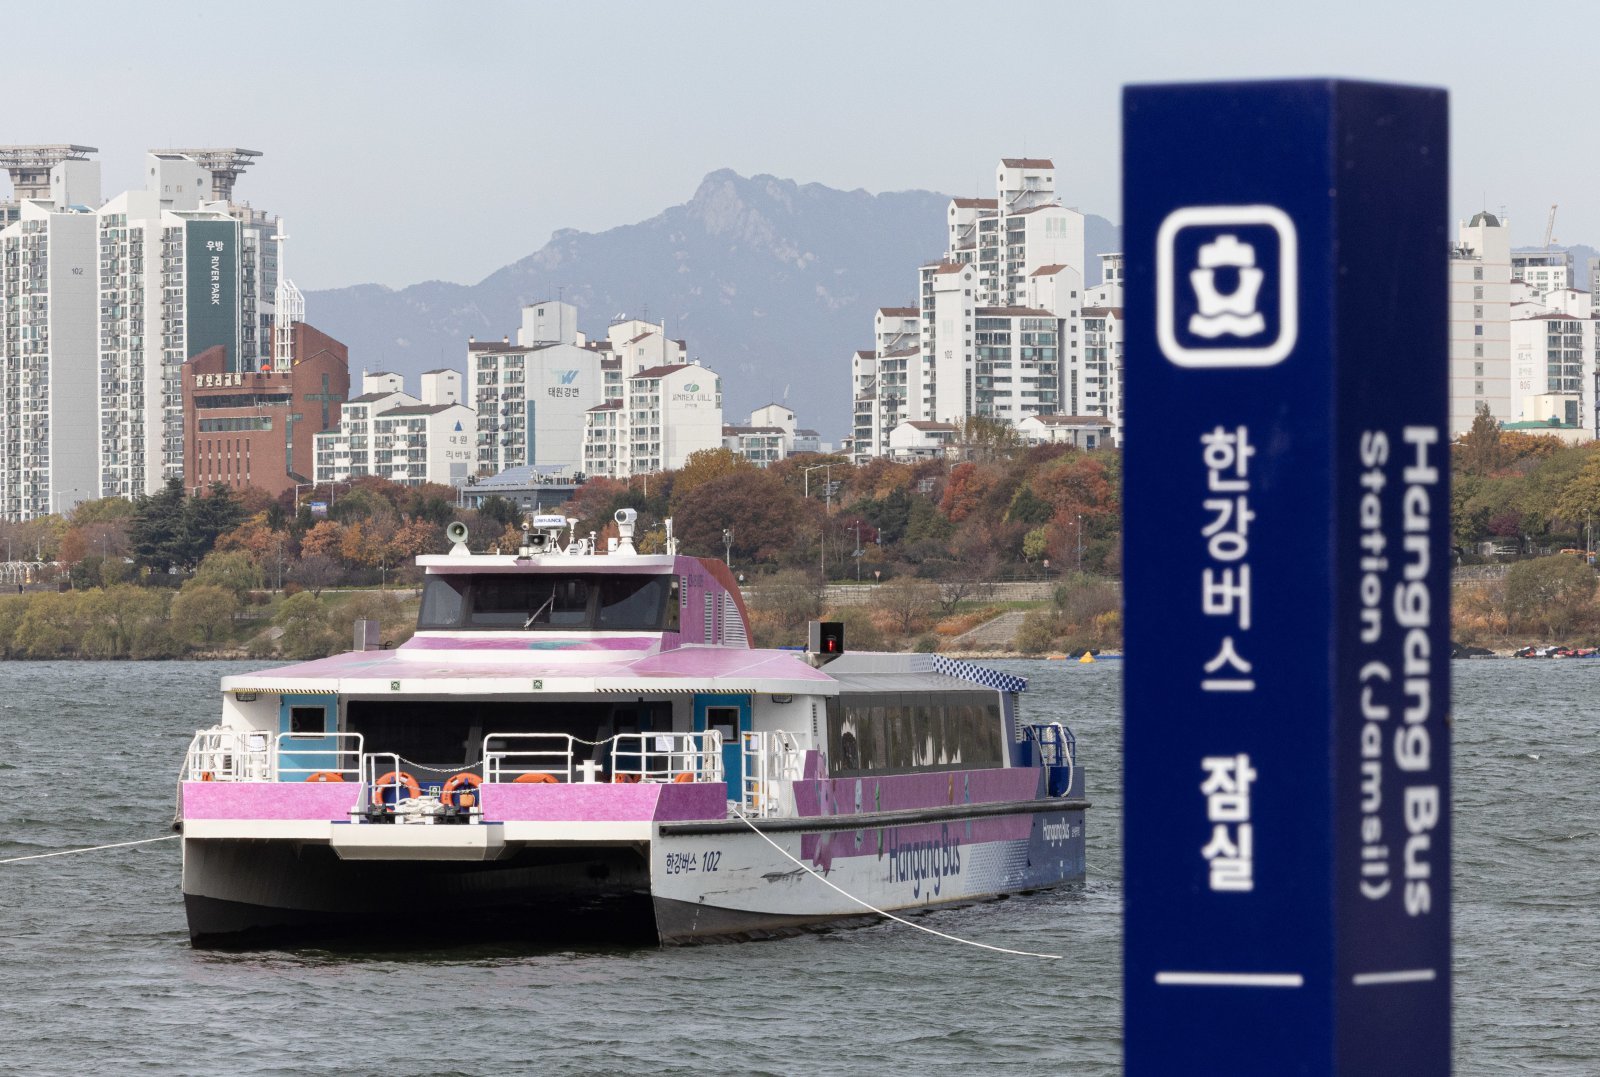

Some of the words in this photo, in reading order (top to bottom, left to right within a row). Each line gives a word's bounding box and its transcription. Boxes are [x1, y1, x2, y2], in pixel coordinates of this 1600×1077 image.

[71, 267, 83, 275] 102
[206, 241, 224, 251] 우방
[211, 256, 220, 282] RIVER
[211, 283, 220, 305] PARK
[1199, 425, 1257, 692] 한강버스
[1359, 431, 1390, 644] Station
[1394, 425, 1439, 771] Hangang
[1200, 753, 1257, 891] 잠실
[1359, 660, 1391, 901] (Jamsil)
[666, 852, 697, 875] 한강버스
[702, 850, 722, 873] 102
[889, 827, 941, 899] Hangang
[942, 823, 961, 876] Bus
[1403, 786, 1439, 916] Bus
